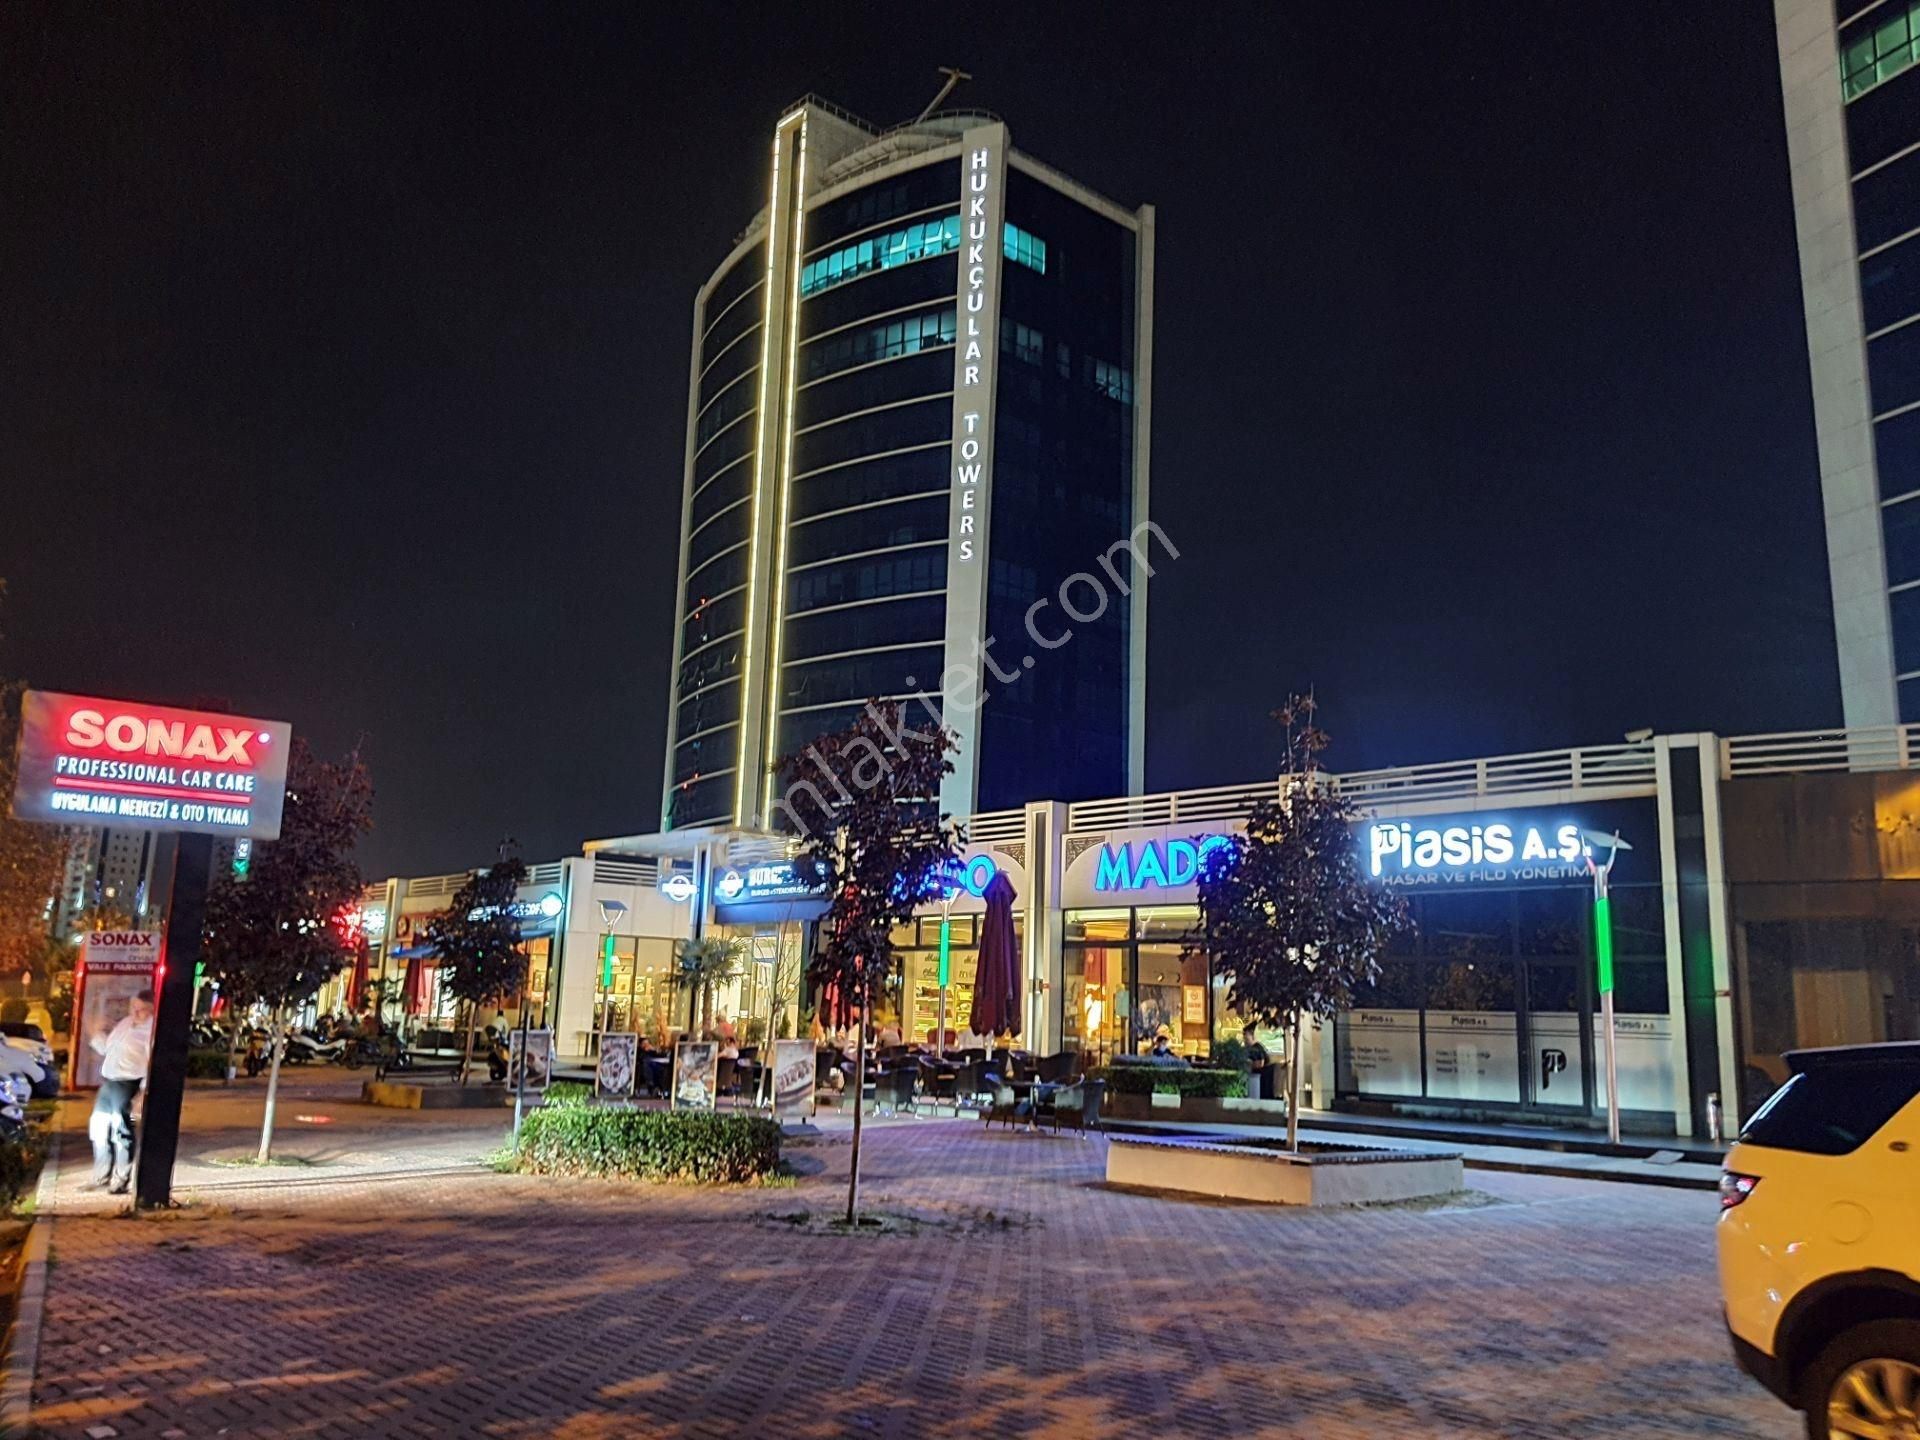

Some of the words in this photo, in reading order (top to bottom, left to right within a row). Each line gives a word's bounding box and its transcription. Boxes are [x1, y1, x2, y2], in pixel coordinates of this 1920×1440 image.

[964, 149, 988, 386] HUKUKÇULAR
[957, 414, 981, 560] TOWERS
[66, 709, 255, 766] SONAX
[56, 756, 177, 786] PROFESSIONAL
[181, 769, 212, 789] CAR
[215, 773, 255, 793] CARE
[51, 792, 117, 815] UYGULAMA
[118, 798, 168, 820] MERKEZİ
[169, 804, 180, 820] &
[182, 807, 204, 822] OTO
[206, 807, 249, 827] YIKAMA
[1521, 825, 1592, 863] A.Ş.
[1382, 872, 1438, 886] HASAR
[1442, 871, 1466, 883] VE
[1511, 864, 1595, 880] YÖNETİM
[91, 933, 152, 946] SONAX
[113, 963, 154, 971] PARKING
